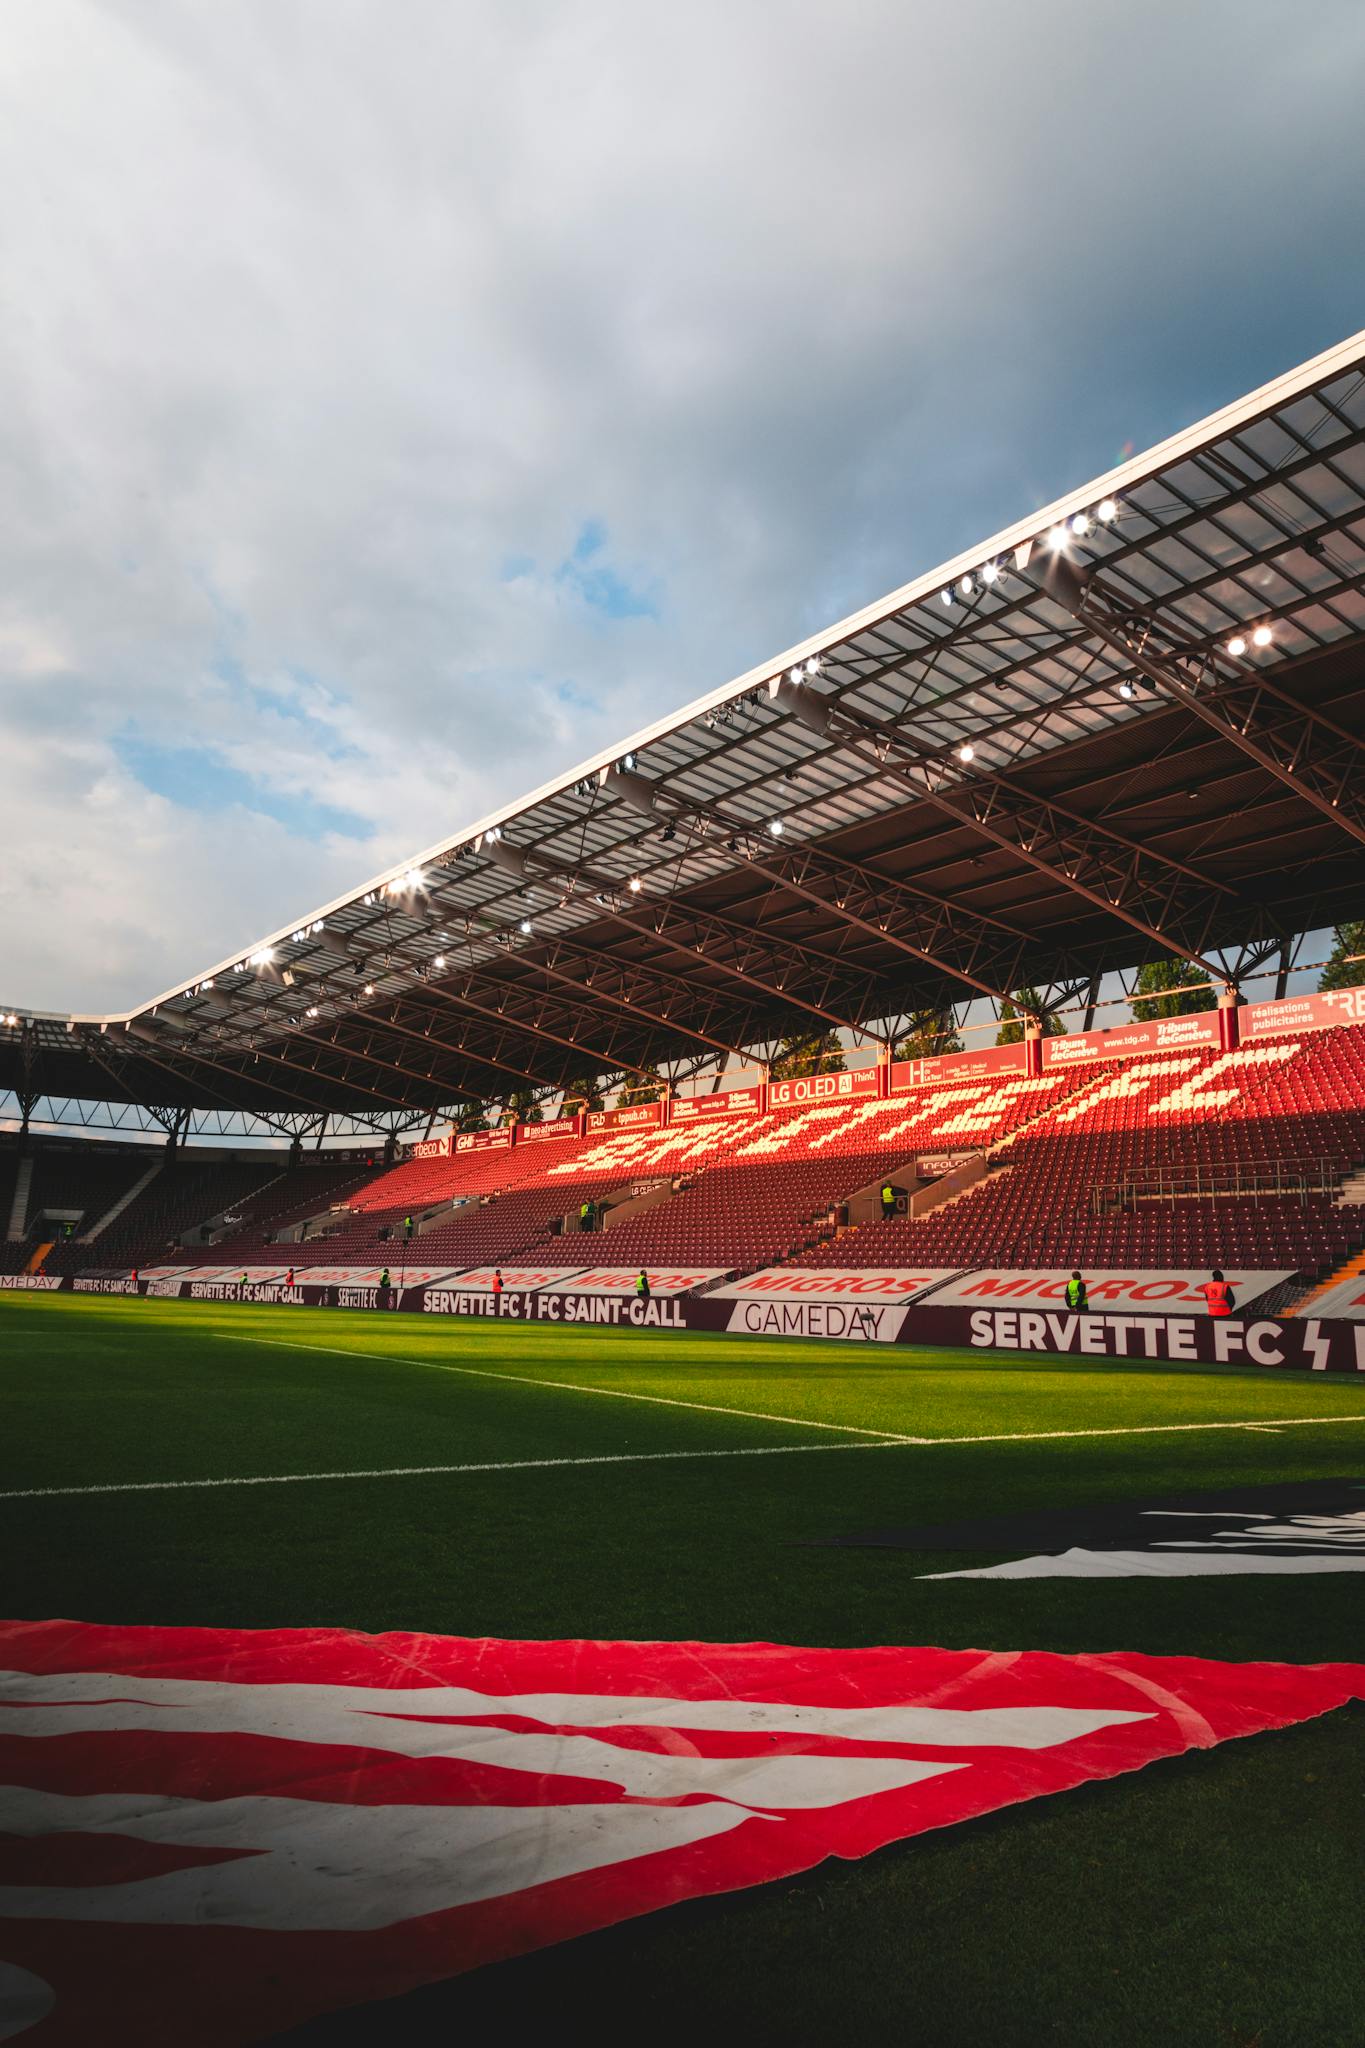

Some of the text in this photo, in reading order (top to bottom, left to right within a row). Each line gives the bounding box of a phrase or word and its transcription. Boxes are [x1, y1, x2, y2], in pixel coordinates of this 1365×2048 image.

[1252, 1002, 1311, 1018] réalisations
[1157, 1020, 1199, 1035] Tribune
[1253, 1013, 1314, 1032] publicitaires
[1051, 1039, 1087, 1051] Tribune
[1104, 1034, 1150, 1048] www.tdg.ch
[771, 1069, 876, 1103] LG OLED AI ThinQ
[618, 1109, 648, 1125] tppub.ch
[541, 1121, 573, 1134] advertising
[406, 1142, 437, 1158] Serbeco
[191, 1283, 304, 1304] SERVETTE FC FC SAINT-GALL
[736, 1276, 932, 1295] MIGROS
[369, 1289, 378, 1308] FC
[423, 1291, 687, 1327] SERVETTE FC FC SAINT-GALL
[745, 1303, 886, 1340] GAMEDAY
[970, 1311, 1285, 1366] SERVETTE FC
